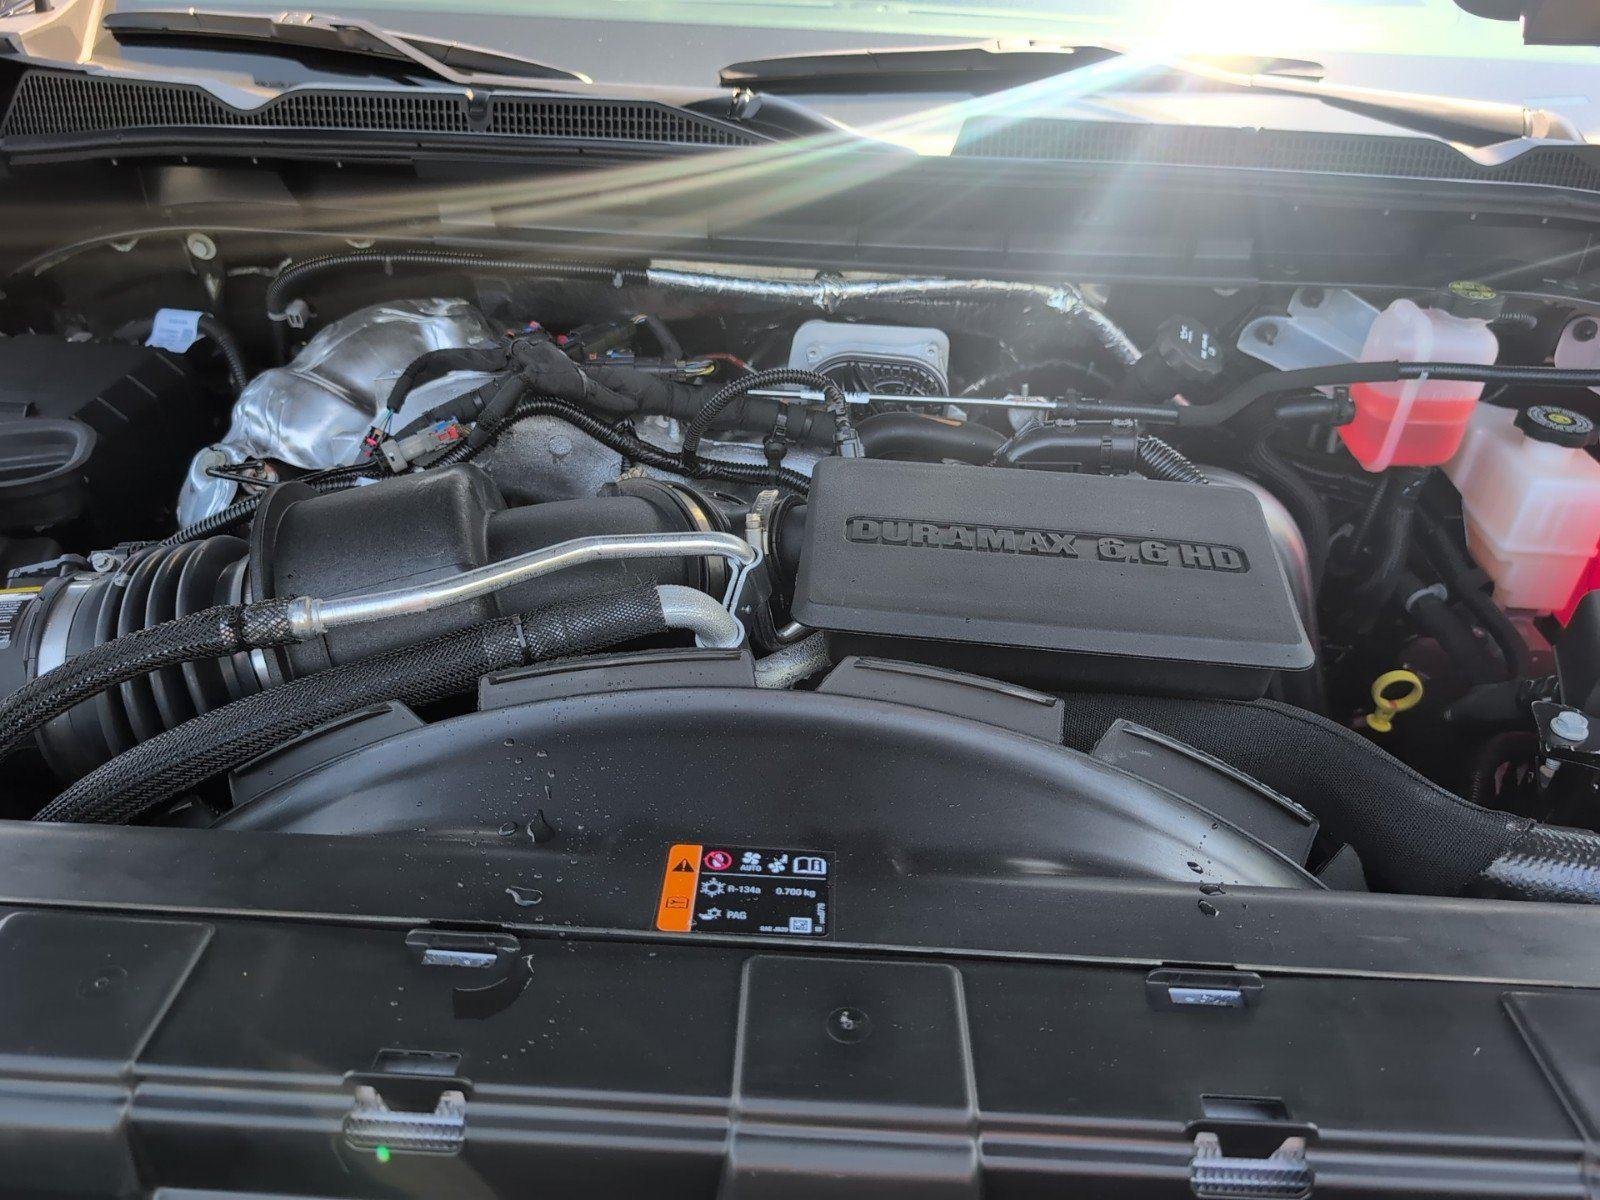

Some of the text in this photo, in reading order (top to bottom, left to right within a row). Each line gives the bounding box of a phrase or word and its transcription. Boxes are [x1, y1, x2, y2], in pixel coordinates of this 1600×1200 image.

[852, 517, 1243, 573] DURAMAX 6.6 HD
[740, 864, 762, 872] AUTO
[727, 884, 762, 895] R-134a
[803, 889, 817, 898] kg
[726, 911, 748, 920] PAG
